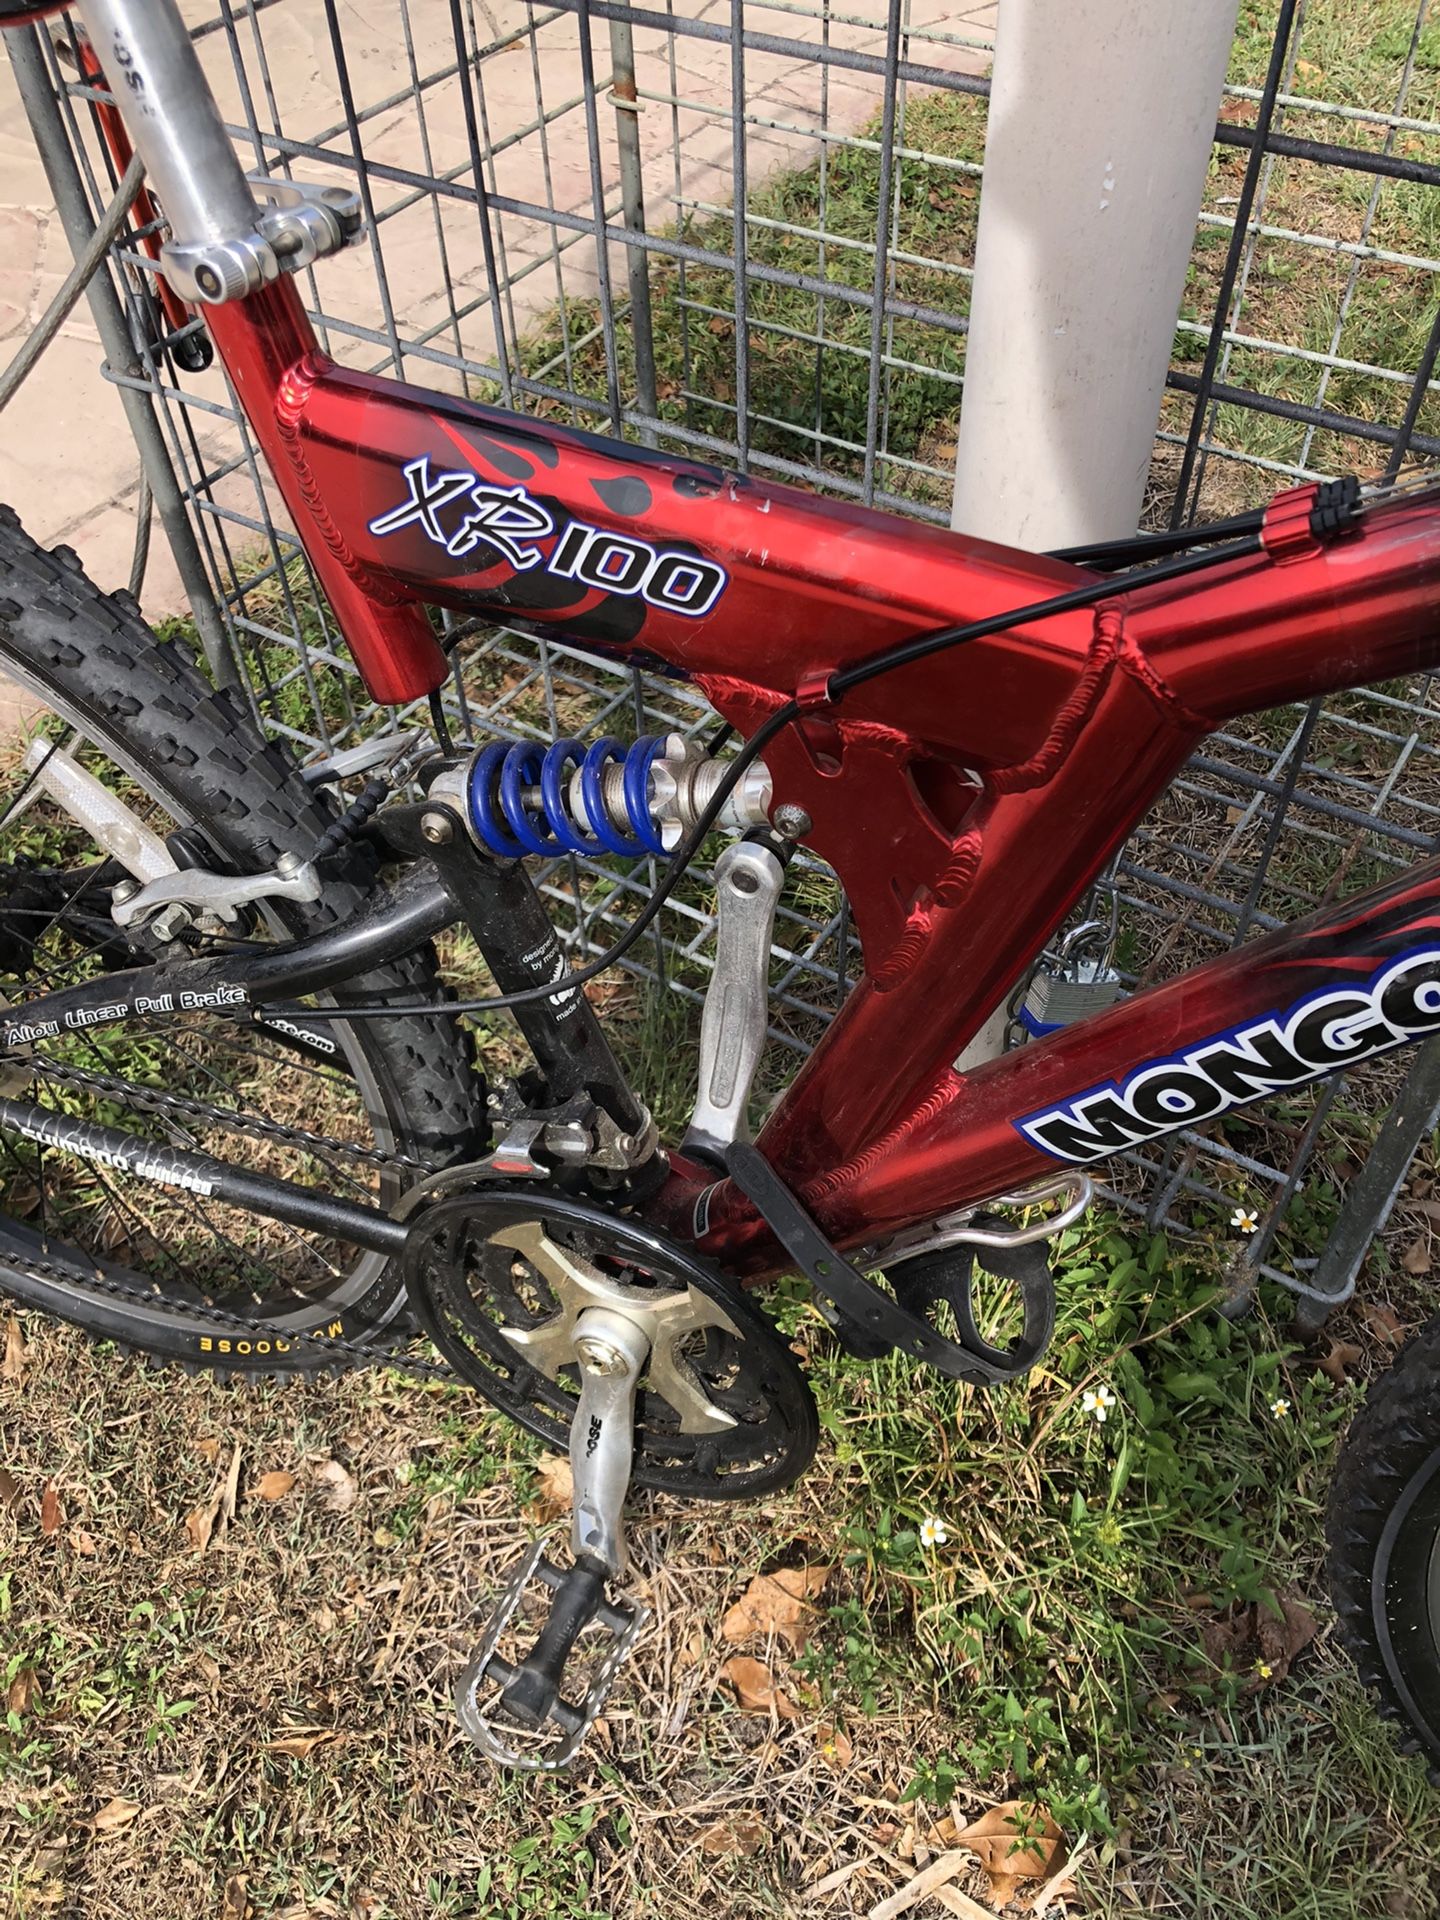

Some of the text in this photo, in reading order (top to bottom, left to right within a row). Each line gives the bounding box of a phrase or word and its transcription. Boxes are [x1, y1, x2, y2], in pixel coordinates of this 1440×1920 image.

[522, 935, 554, 963] designed
[531, 961, 543, 971] by
[8, 986, 246, 1047] Alloy Linear Pull Brake
[556, 1003, 577, 1021] made
